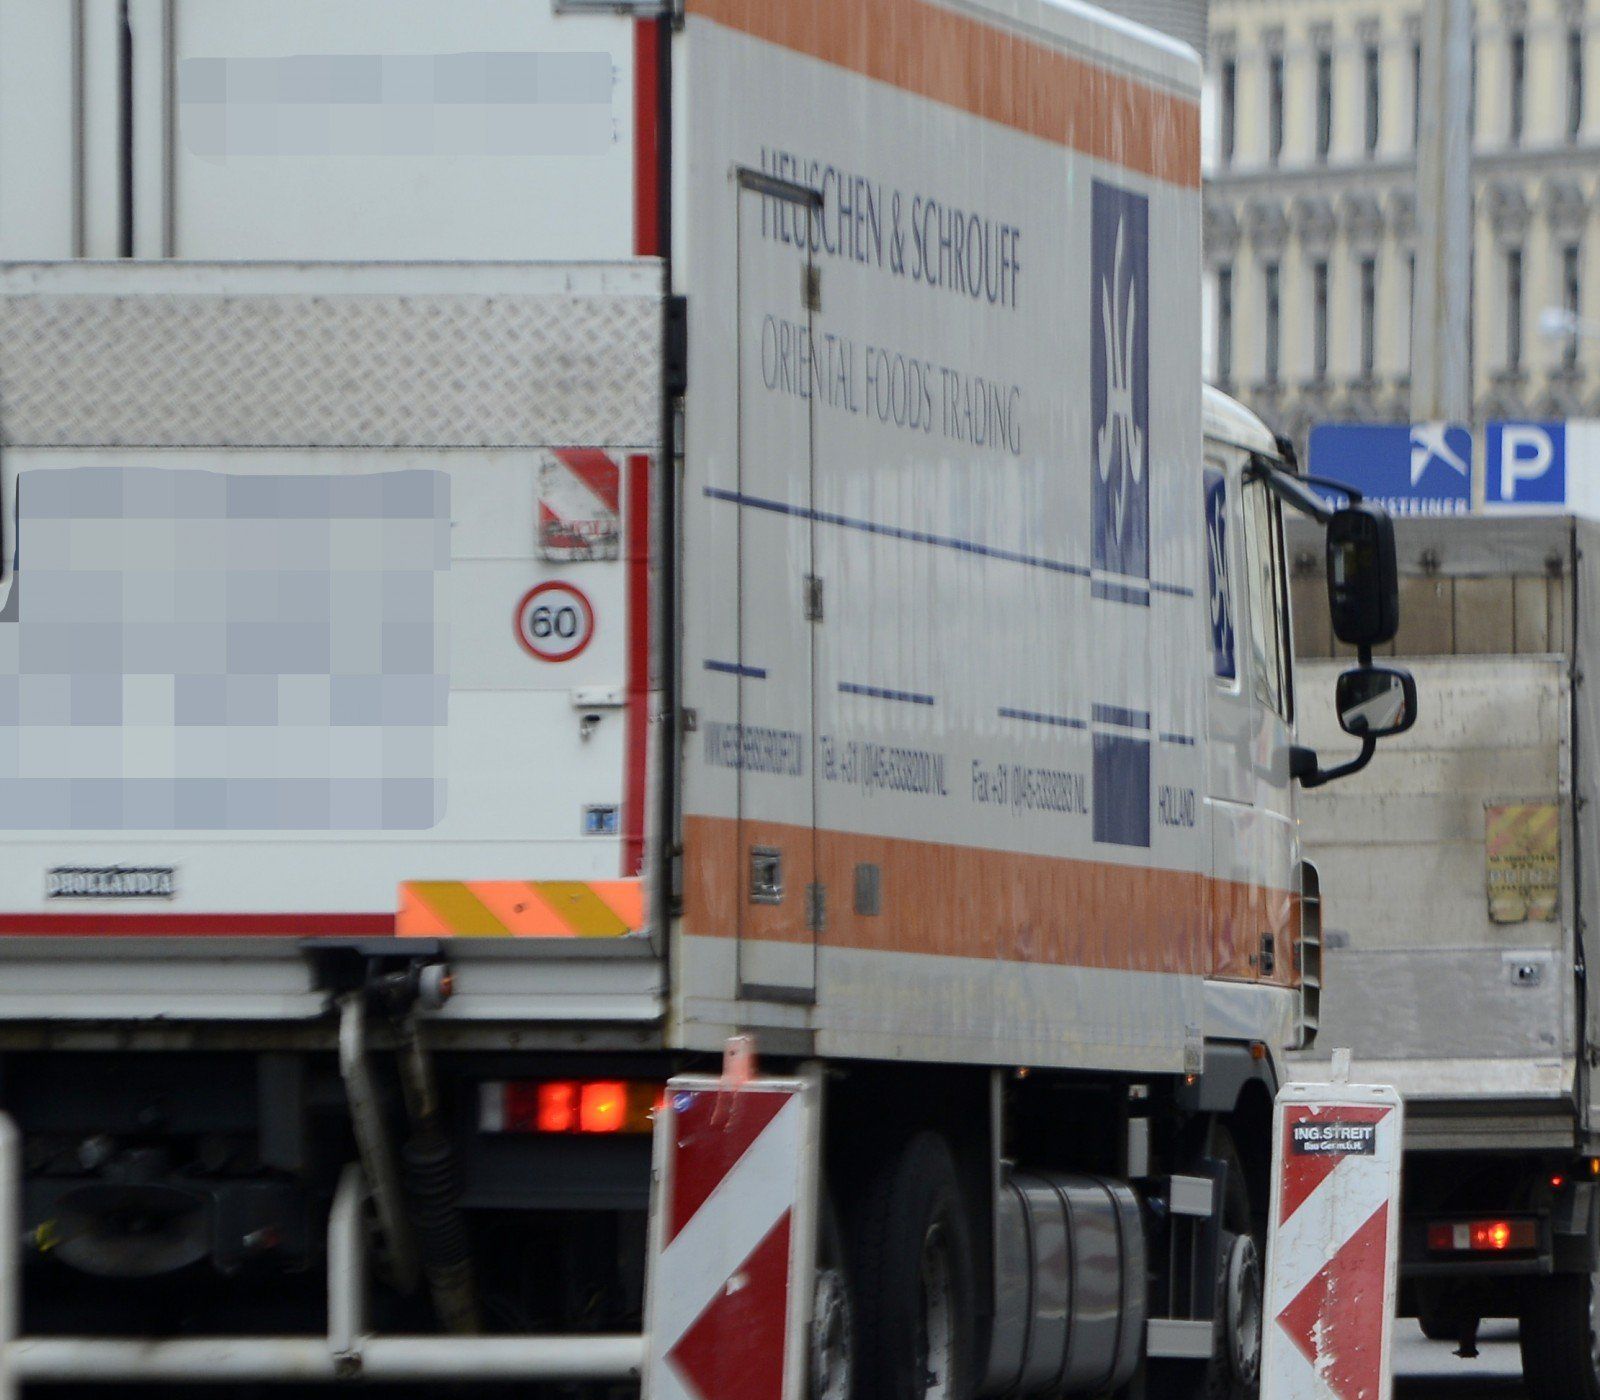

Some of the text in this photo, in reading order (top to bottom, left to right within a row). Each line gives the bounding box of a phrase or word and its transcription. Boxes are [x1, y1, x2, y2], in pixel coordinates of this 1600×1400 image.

[761, 146, 1021, 307] HEUSCHEN & SCHROUFF
[761, 314, 1021, 456] ORIENTAL FOODS TRADING
[1501, 425, 1553, 500] P
[530, 606, 577, 638] 60
[971, 759, 989, 803] Fax
[1158, 784, 1196, 828] HOLLAND
[1294, 1127, 1374, 1140] ING.STREIT
